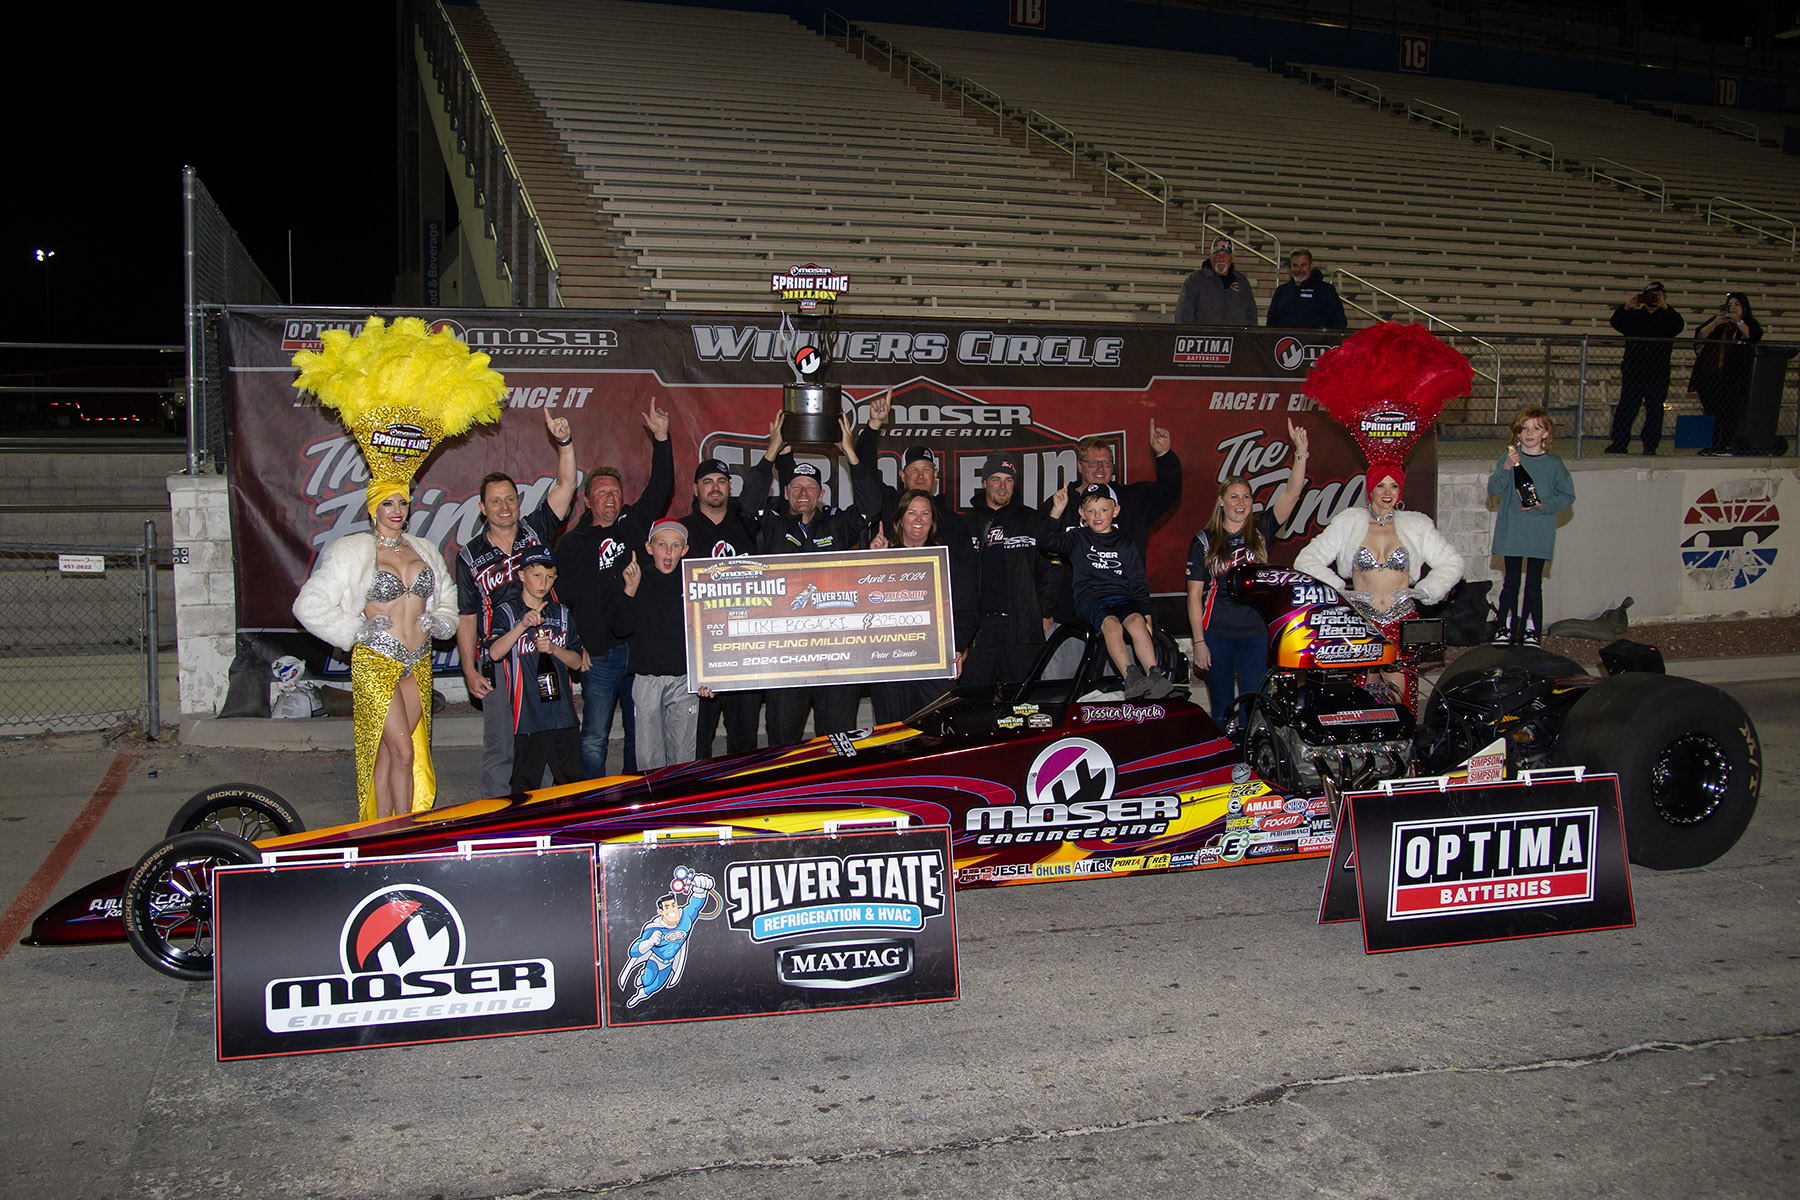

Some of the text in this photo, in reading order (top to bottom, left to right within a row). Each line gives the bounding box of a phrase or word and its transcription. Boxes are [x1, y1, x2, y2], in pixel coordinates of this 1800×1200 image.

[1402, 39, 1426, 68] 1C
[1717, 78, 1737, 105] 1D
[428, 223, 440, 277] Beverage
[773, 275, 848, 292] SPRING FLING
[782, 290, 837, 300] MILLION
[467, 328, 618, 347] MOSER
[477, 348, 609, 356] ENGINEERING
[957, 331, 1124, 367] CIRCLE
[1177, 339, 1230, 353] OPTIMA
[563, 387, 594, 408] IT
[1209, 391, 1258, 410] RACE
[1258, 393, 1280, 411] IT
[1361, 420, 1392, 431] SPRING
[372, 432, 431, 451] SPRING FLING
[380, 445, 421, 457] MILLION
[1218, 431, 1294, 478] The
[476, 564, 504, 595] The
[858, 573, 886, 585] April
[900, 571, 927, 582] 2024
[689, 578, 787, 600] SPRING FLING
[901, 589, 928, 599] STRIP
[703, 596, 774, 611] MILLION
[811, 591, 838, 606] SILVER
[838, 590, 858, 604] STATE
[785, 615, 849, 633] BOGACKI
[1310, 613, 1367, 625] Bracket
[706, 623, 725, 632] PAY
[1319, 624, 1366, 638] Racing
[517, 633, 536, 654] The
[712, 632, 926, 652] SPRING FLING MILLION WINNER
[1316, 643, 1383, 656] ACCELERATED
[742, 656, 778, 666] 2024
[779, 652, 850, 664] CHAMPION
[871, 651, 890, 660] Peter
[1082, 704, 1165, 724] Jessica Bogacki
[1320, 713, 1365, 722] HUNTSVILLE
[1470, 756, 1500, 768] SIMPSON
[1470, 770, 1500, 782] SIMPSON
[206, 789, 294, 823] MICKEY THOMPSON
[966, 796, 1179, 831] MOSER
[1246, 799, 1283, 813] AMALIE
[1286, 801, 1307, 812] NHRA
[1227, 817, 1255, 828] JEGS
[1263, 816, 1299, 829] FOGGIT
[977, 823, 1168, 845] ENGINEERING
[1269, 829, 1310, 838] PERFORMANCE
[1200, 847, 1223, 856] PRO
[1405, 823, 1584, 879] OPTIMA
[992, 864, 1032, 877] JESEL
[1035, 864, 1071, 877] ÖHLINS
[1074, 859, 1112, 873] AirTek
[124, 891, 136, 932] MICKEY
[130, 843, 174, 893] THOMPSON
[729, 854, 941, 923] SILVER STATE
[1440, 879, 1552, 905] BATTERIES
[763, 908, 913, 932] REFRIGERATION & HVAC
[791, 949, 900, 974] MAYTAG
[271, 961, 548, 1010] MOSER
[287, 996, 533, 1028] ENGINEERING
